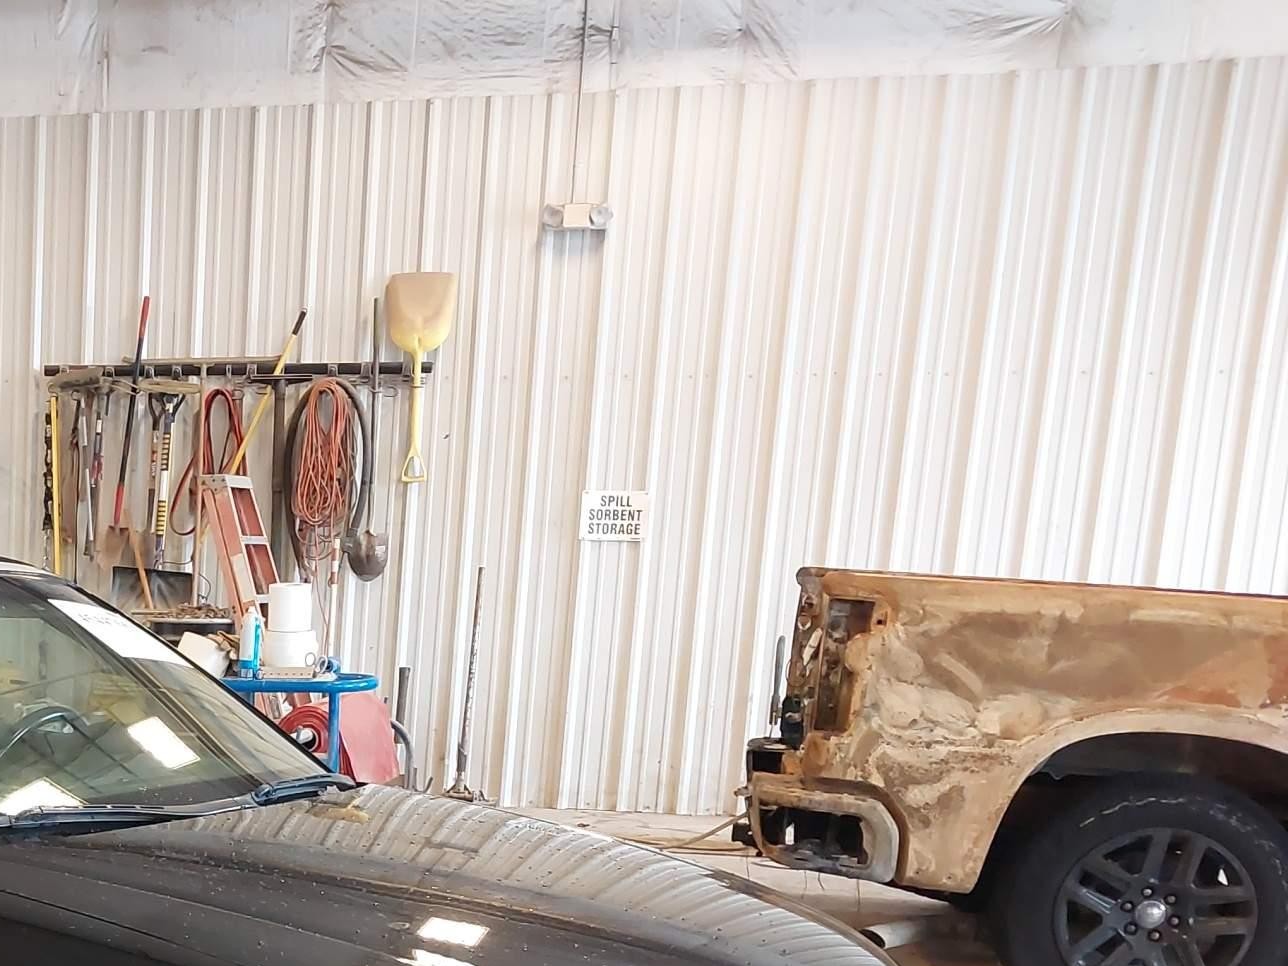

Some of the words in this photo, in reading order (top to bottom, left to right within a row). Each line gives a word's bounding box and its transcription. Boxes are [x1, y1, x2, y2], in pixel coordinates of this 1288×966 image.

[600, 495, 632, 507] SPILL
[588, 509, 643, 521] SORBENT
[588, 522, 641, 535] STORAGE
